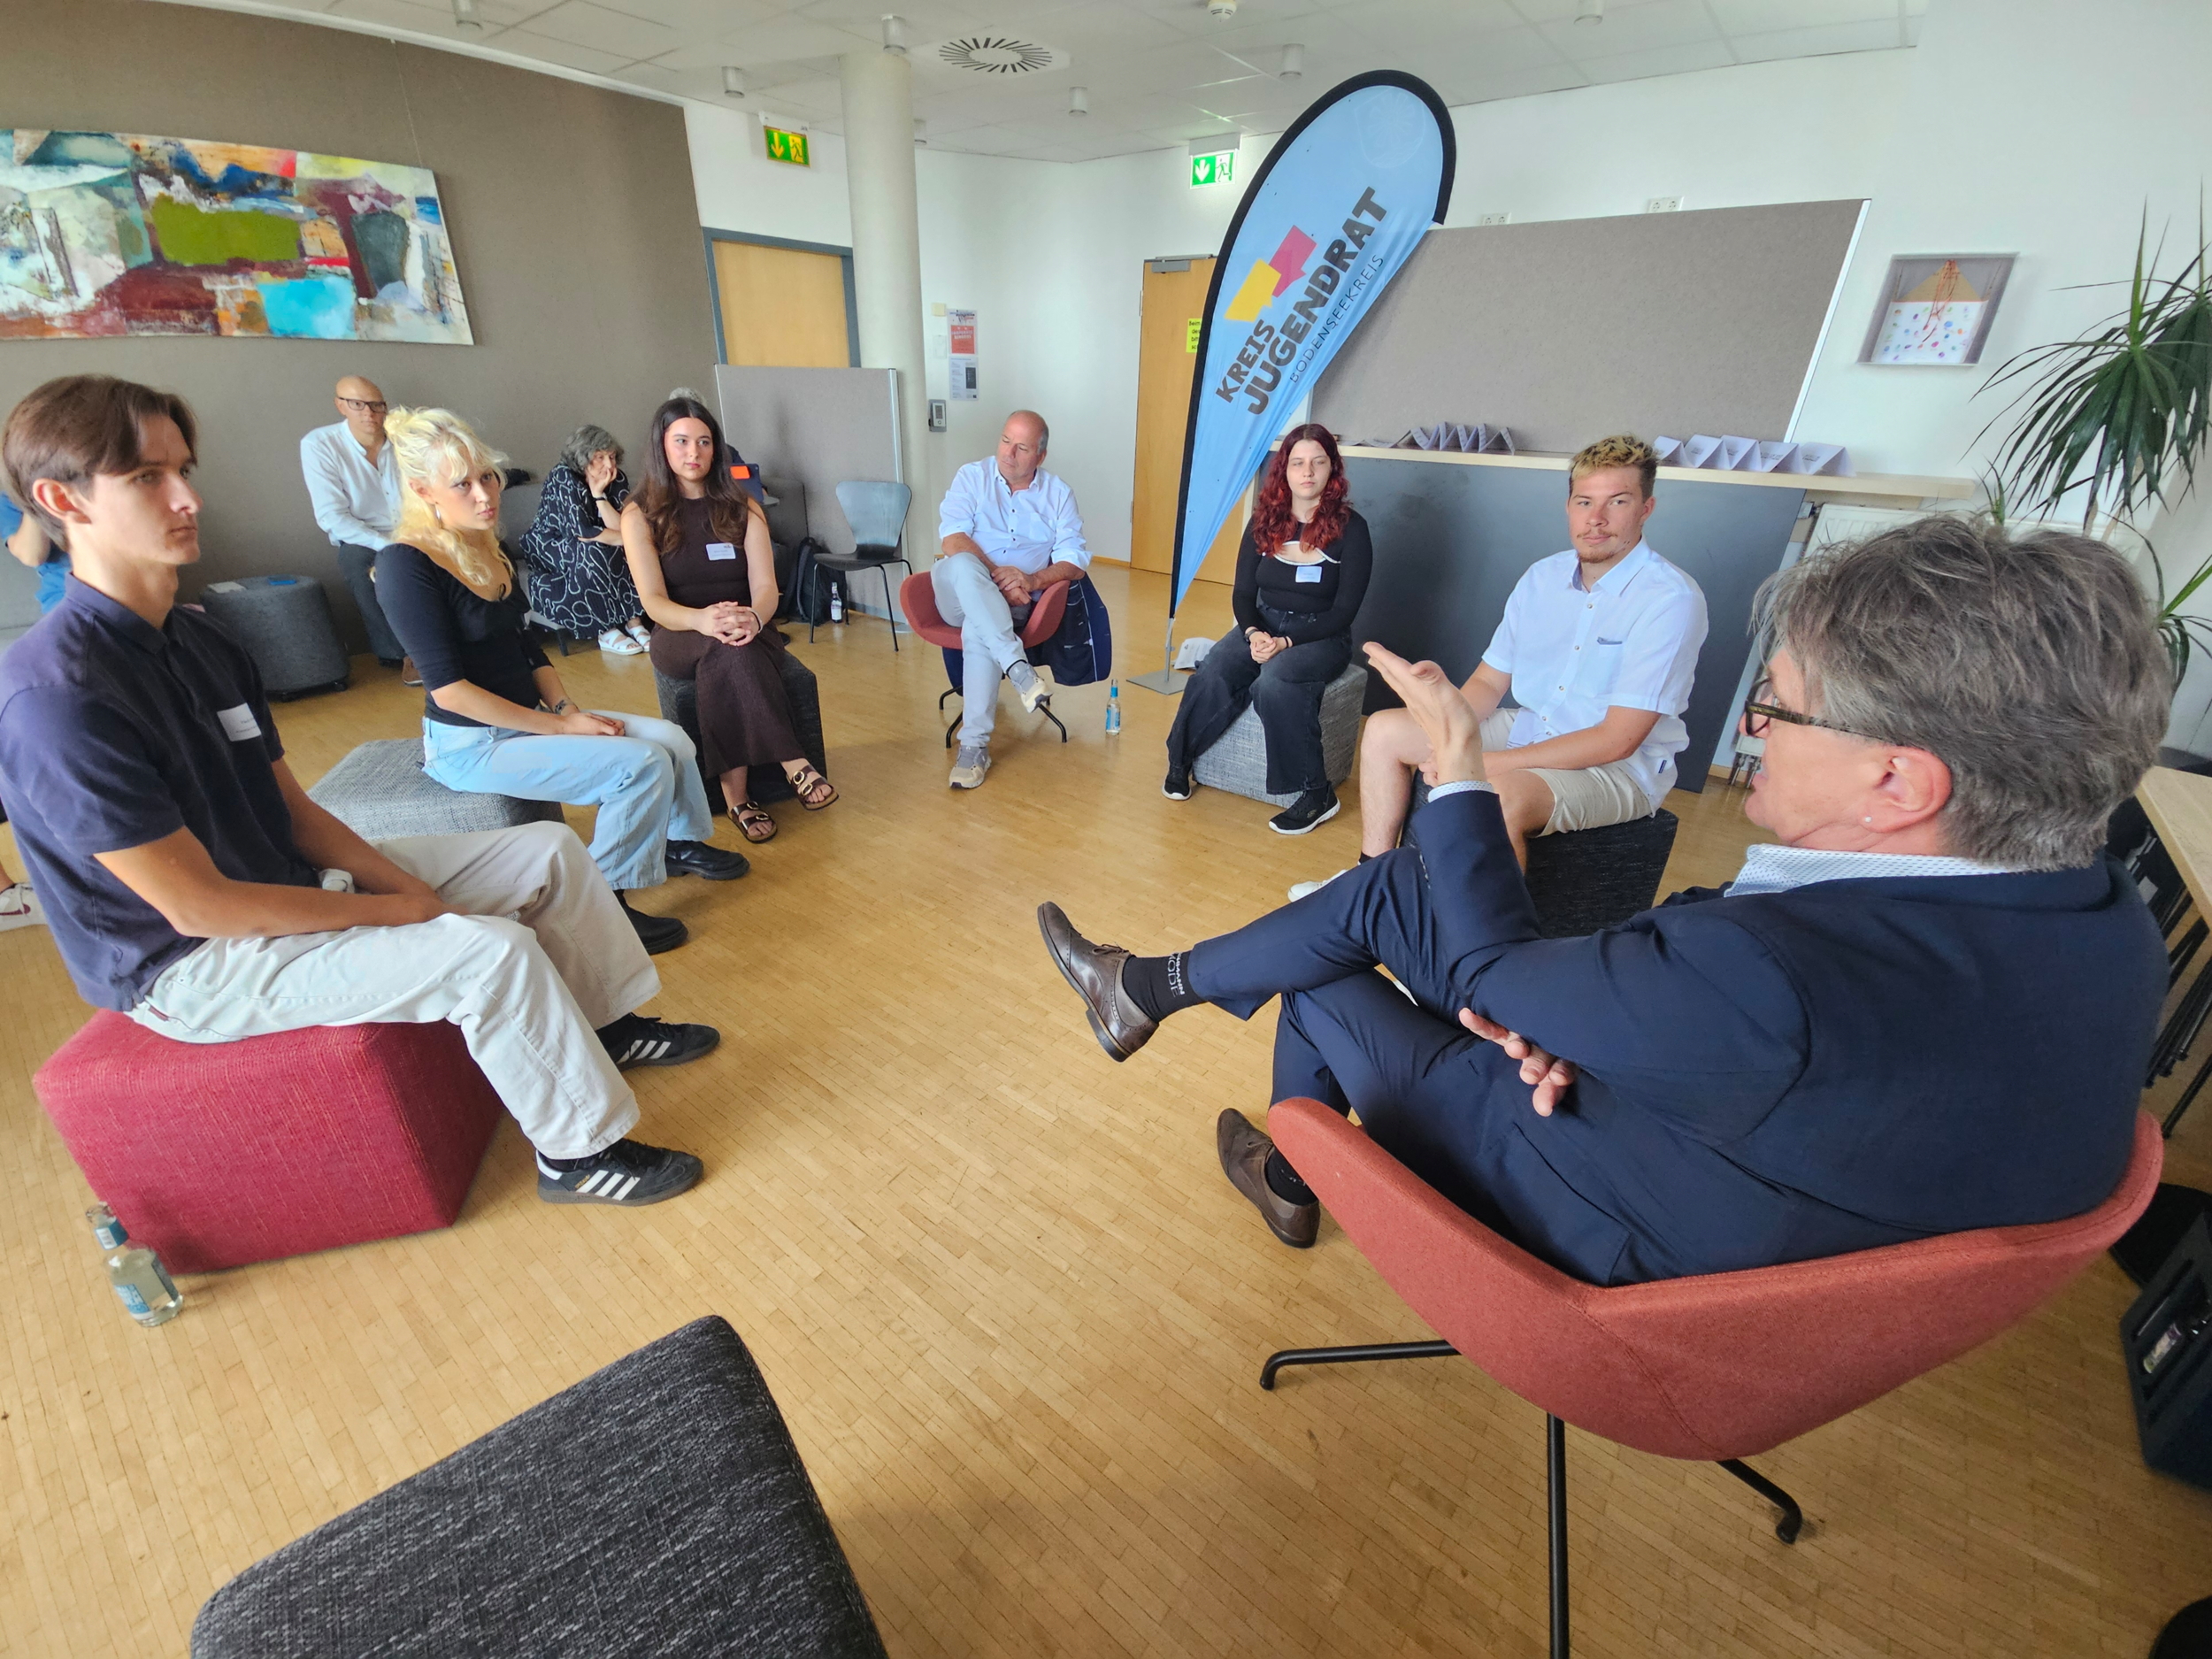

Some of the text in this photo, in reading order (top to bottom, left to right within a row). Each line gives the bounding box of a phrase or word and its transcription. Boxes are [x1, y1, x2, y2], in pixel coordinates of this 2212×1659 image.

[1215, 319, 1275, 403] KREIS
[1244, 186, 1387, 415] JUGENDRAT
[1289, 254, 1384, 384] BODENSEEKREIS
